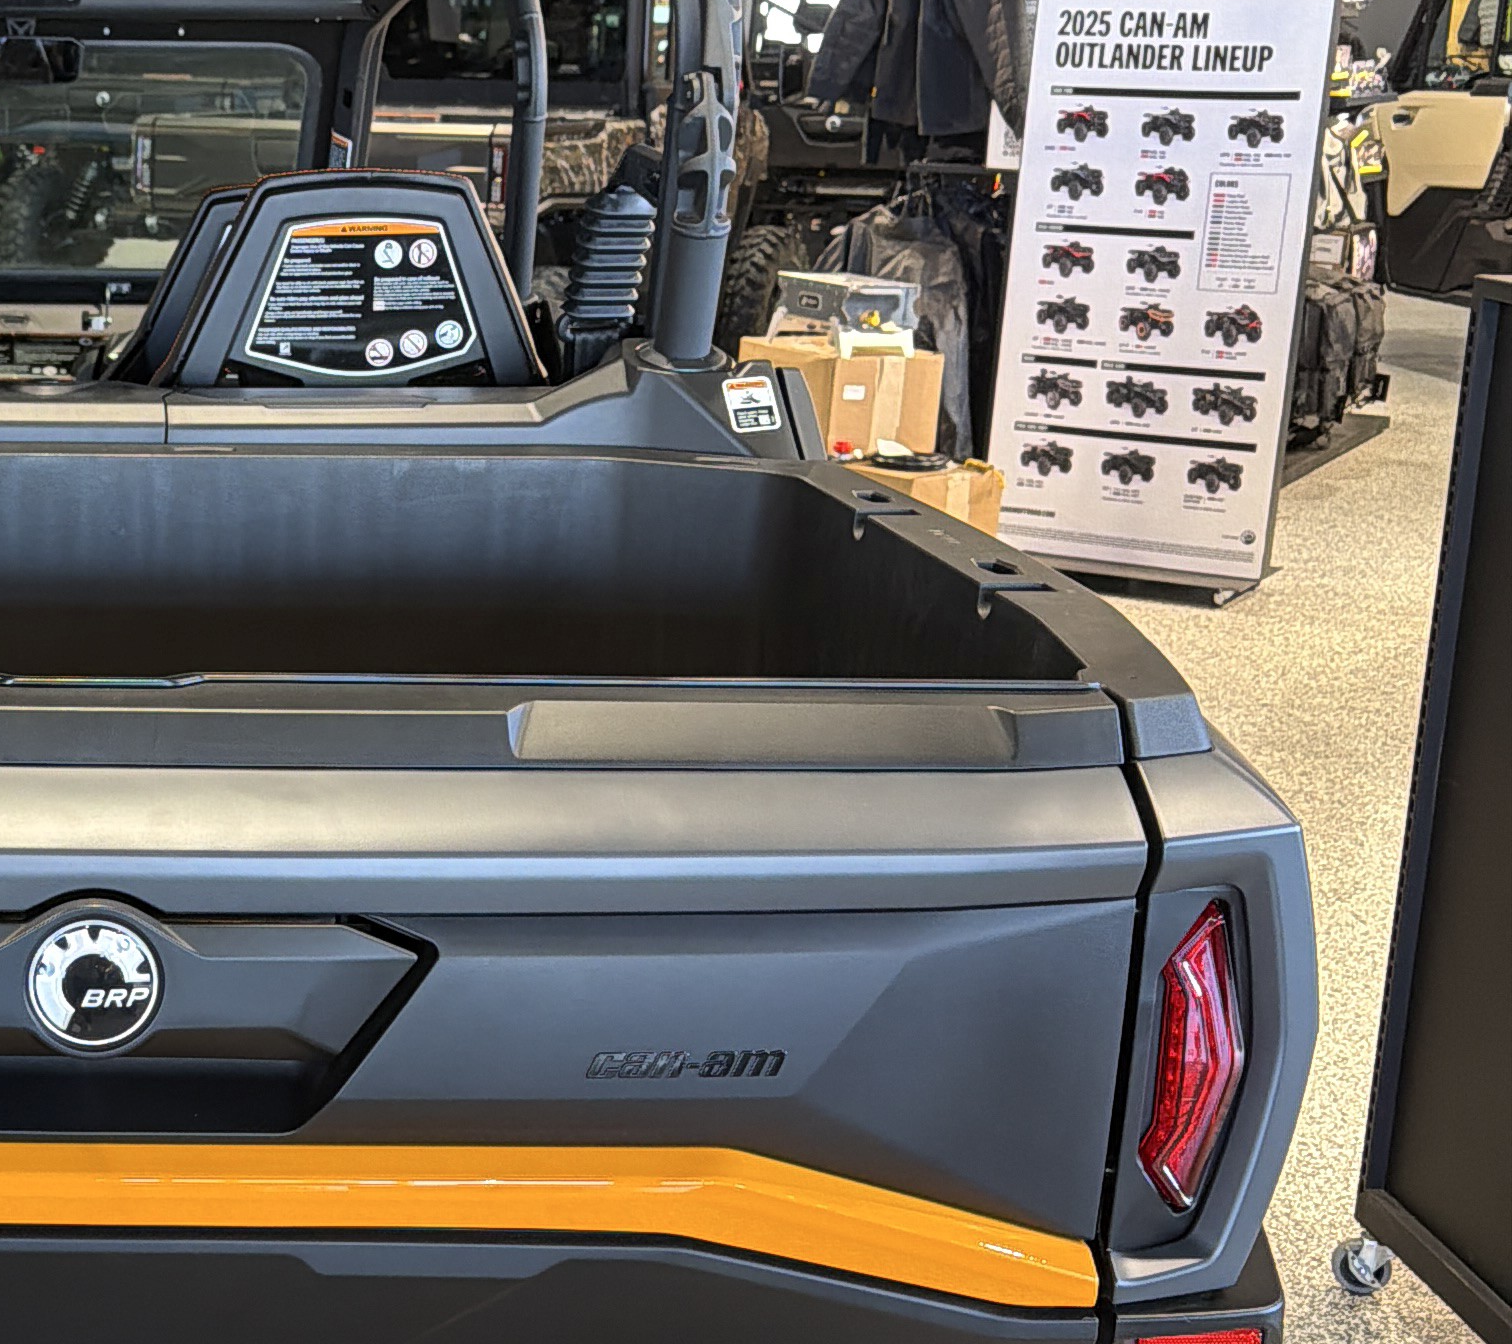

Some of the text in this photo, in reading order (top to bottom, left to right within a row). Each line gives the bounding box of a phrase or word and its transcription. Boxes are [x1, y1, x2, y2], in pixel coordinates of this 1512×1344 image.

[1057, 9, 1210, 40] 2025 CAN-AM
[1055, 42, 1274, 73] OUTLANDER LINEUP
[349, 224, 389, 233] WARNING
[80, 988, 151, 1008] BRP
[585, 1049, 788, 1080] can-am
